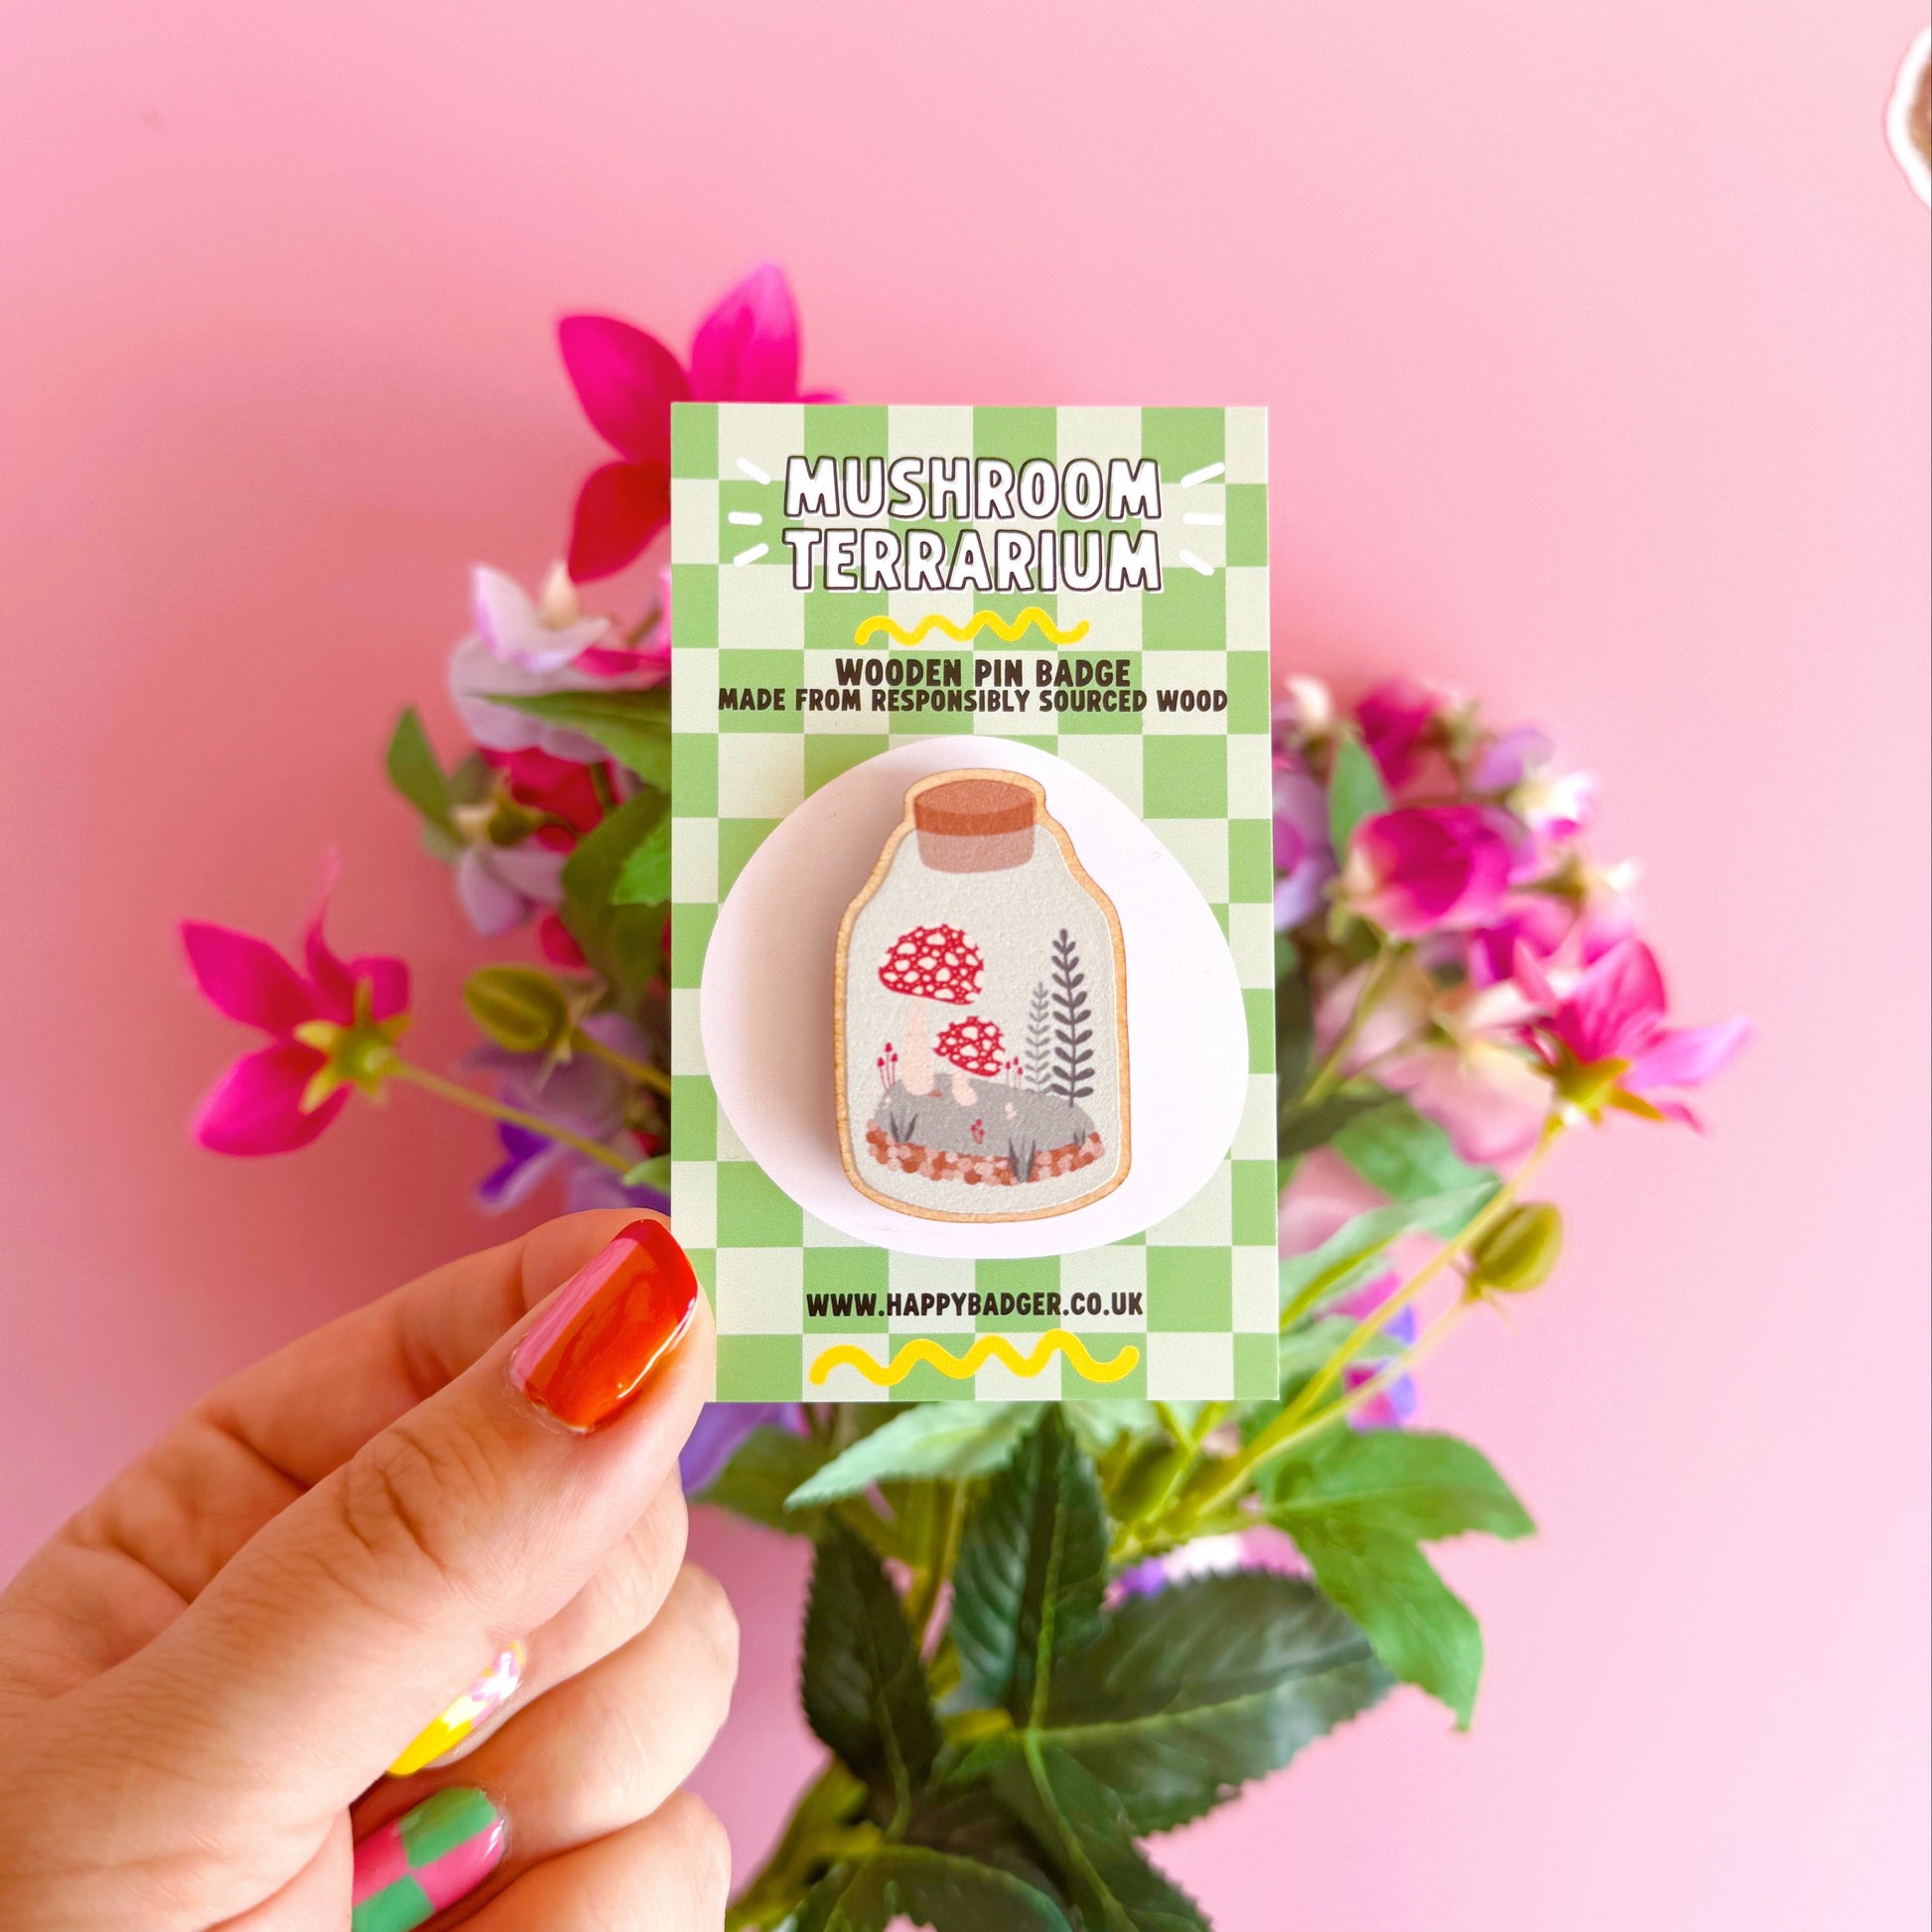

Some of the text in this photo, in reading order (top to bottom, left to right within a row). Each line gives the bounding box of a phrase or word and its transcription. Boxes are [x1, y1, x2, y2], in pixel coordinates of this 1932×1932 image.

[784, 456, 1161, 519] MUSHROOM
[782, 528, 1161, 592] TERRARIUM
[836, 658, 1130, 687] WOODEN PIN BADGE
[719, 688, 1227, 712] MADE FROM RESPONSIBLY SOURCED WOOD
[806, 1293, 1143, 1316] WWW.HAPPYBADGER.CO.UK
